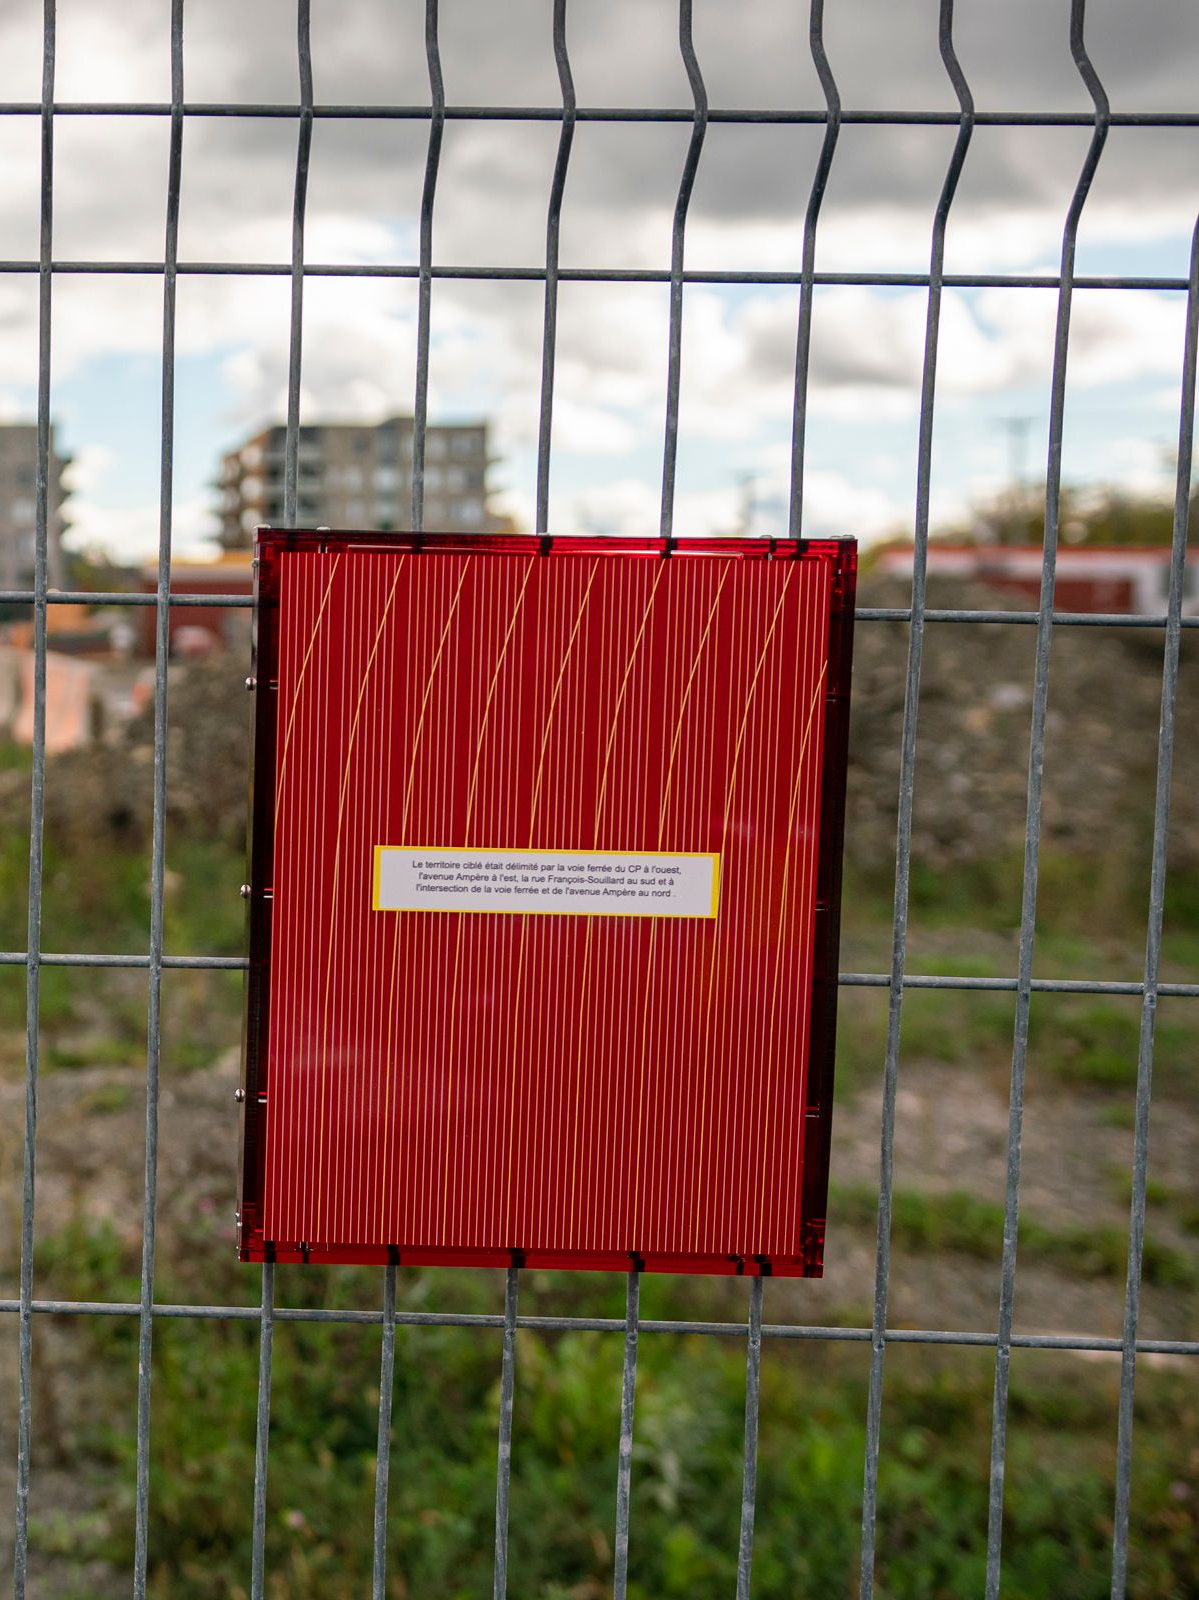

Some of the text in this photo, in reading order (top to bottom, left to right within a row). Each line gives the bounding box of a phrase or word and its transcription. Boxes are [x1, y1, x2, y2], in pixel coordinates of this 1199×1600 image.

[412, 860, 423, 869] Le
[425, 861, 460, 869] territoire
[463, 861, 482, 869] ciblé
[485, 862, 503, 870] était
[505, 862, 538, 870] délimité
[541, 864, 554, 872] par
[567, 864, 585, 872] voie
[587, 864, 612, 872] ferrée
[615, 865, 626, 873] du
[628, 865, 641, 873] CP
[644, 865, 649, 873] à
[651, 865, 681, 875] l'ouest,
[418, 872, 454, 880] l'avenue
[456, 873, 489, 882] Ampère
[492, 873, 497, 881] à
[500, 874, 519, 883] l'est,
[521, 874, 529, 882] la
[548, 875, 625, 884] François-Souillard
[640, 877, 656, 885] sud
[416, 884, 468, 892] l'intersection
[471, 885, 482, 893] de
[484, 885, 492, 893] la
[494, 885, 512, 893] voie
[514, 886, 539, 894] ferrée
[552, 887, 563, 895] de
[565, 887, 600, 895] l'avenue
[603, 888, 636, 897] Ampère
[651, 889, 671, 897] nord
